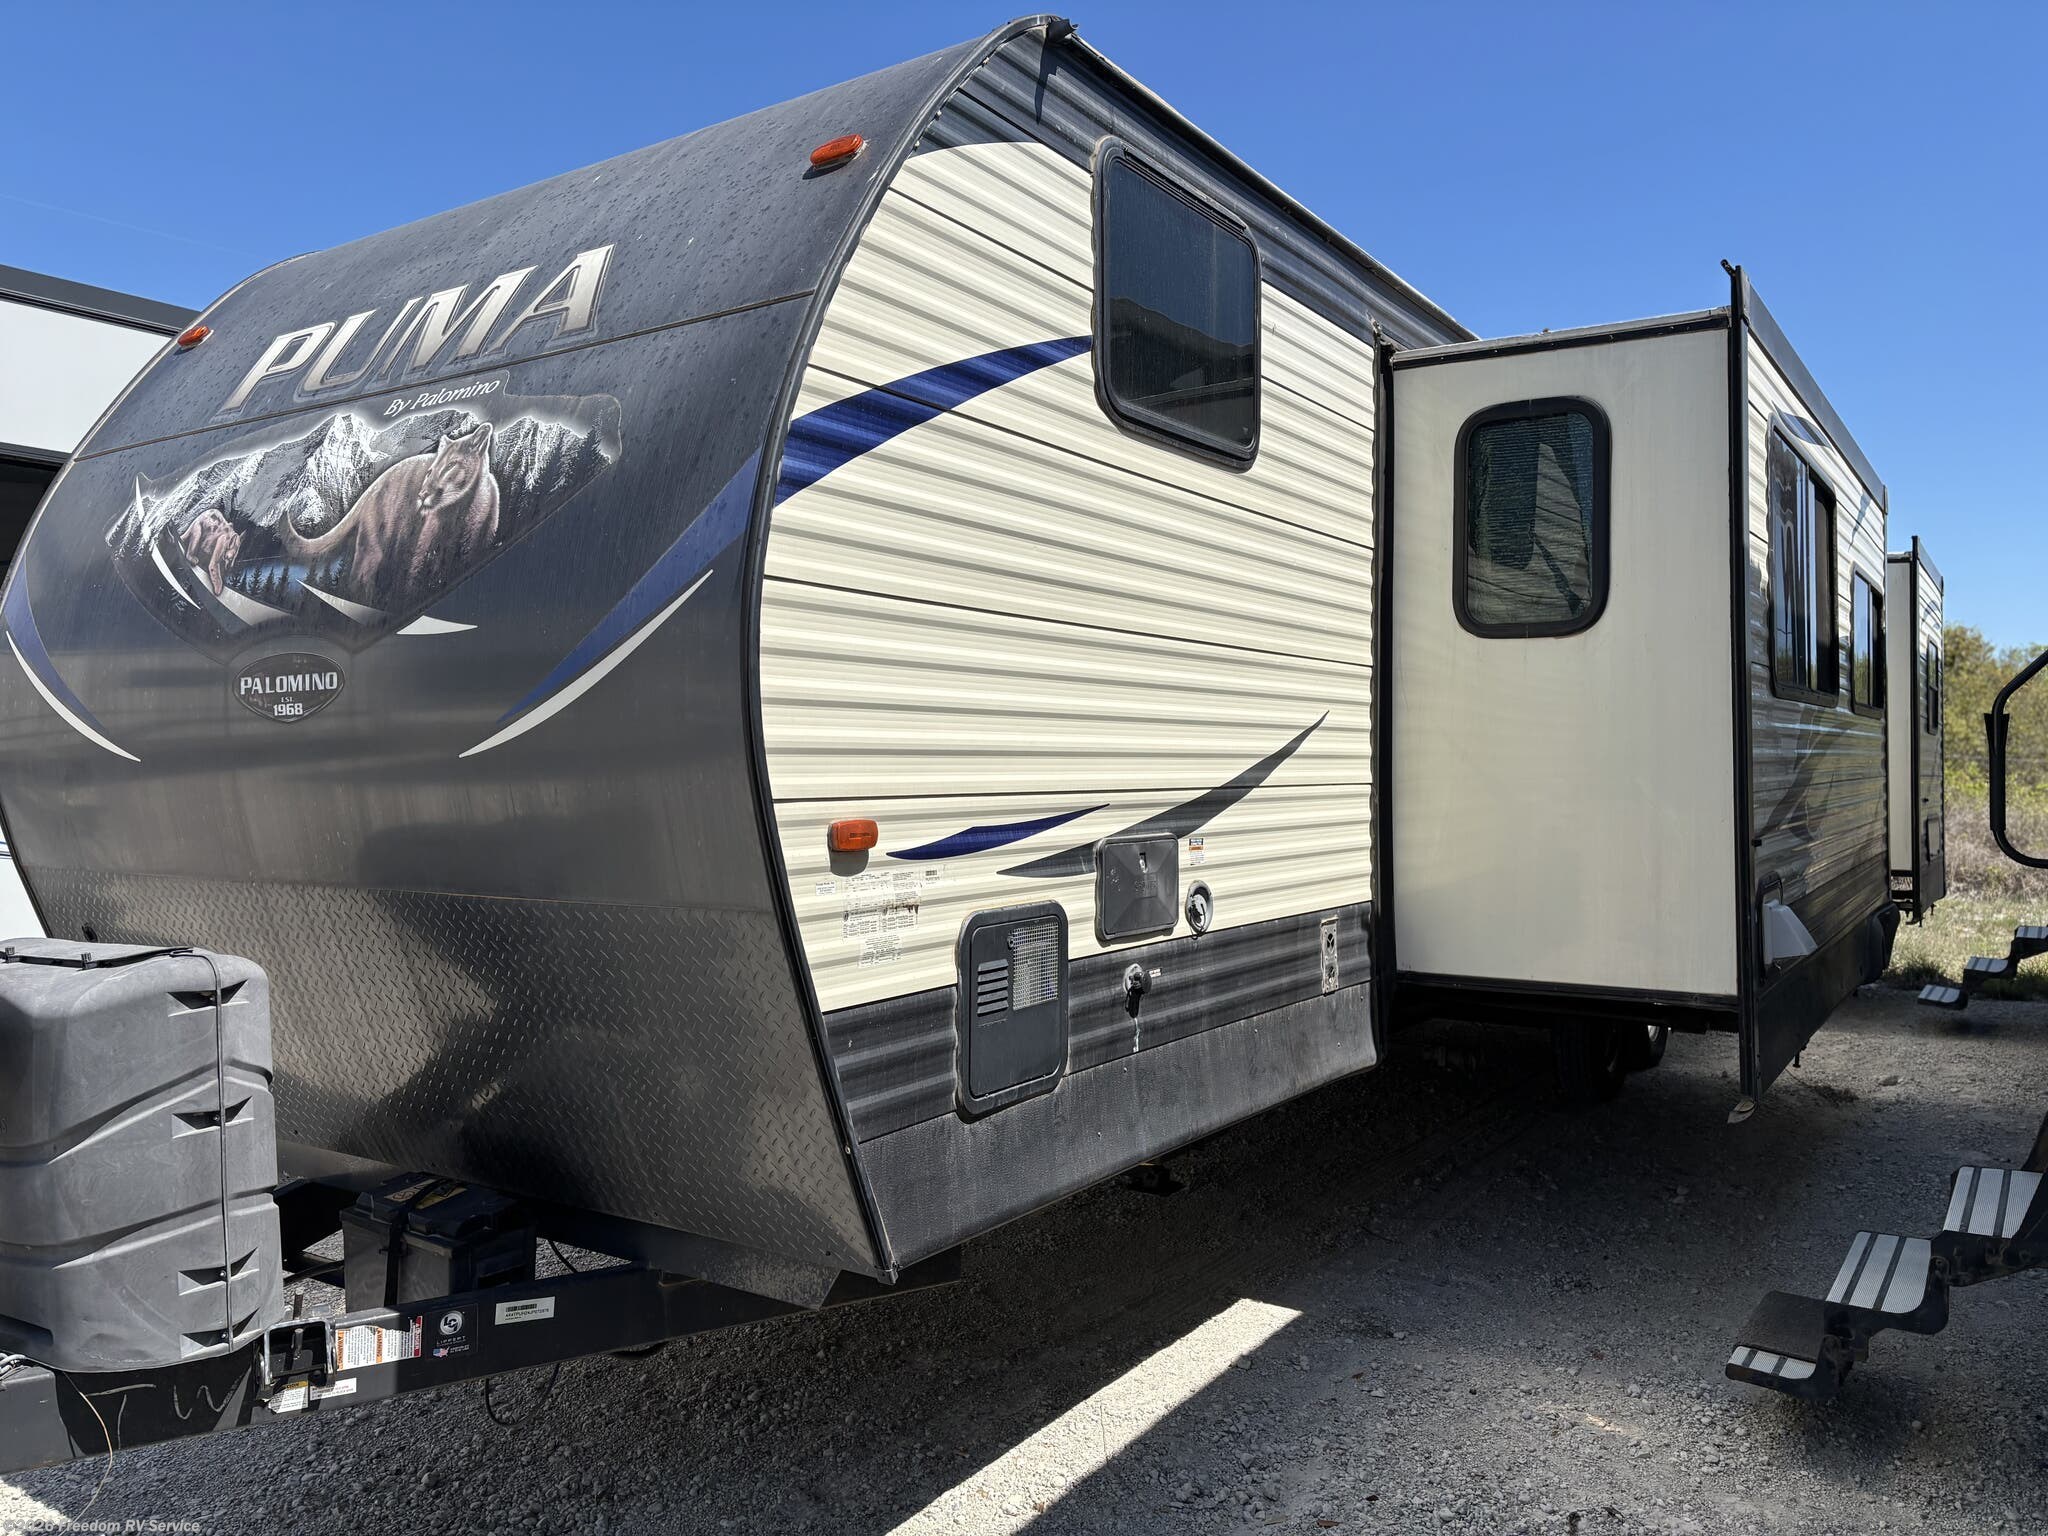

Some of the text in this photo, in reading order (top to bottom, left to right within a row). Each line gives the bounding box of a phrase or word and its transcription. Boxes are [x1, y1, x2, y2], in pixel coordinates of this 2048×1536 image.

[216, 243, 616, 415] PUMA
[383, 380, 501, 417] By Palomino
[240, 671, 338, 695] PALOMINO
[273, 702, 304, 716] 1968
